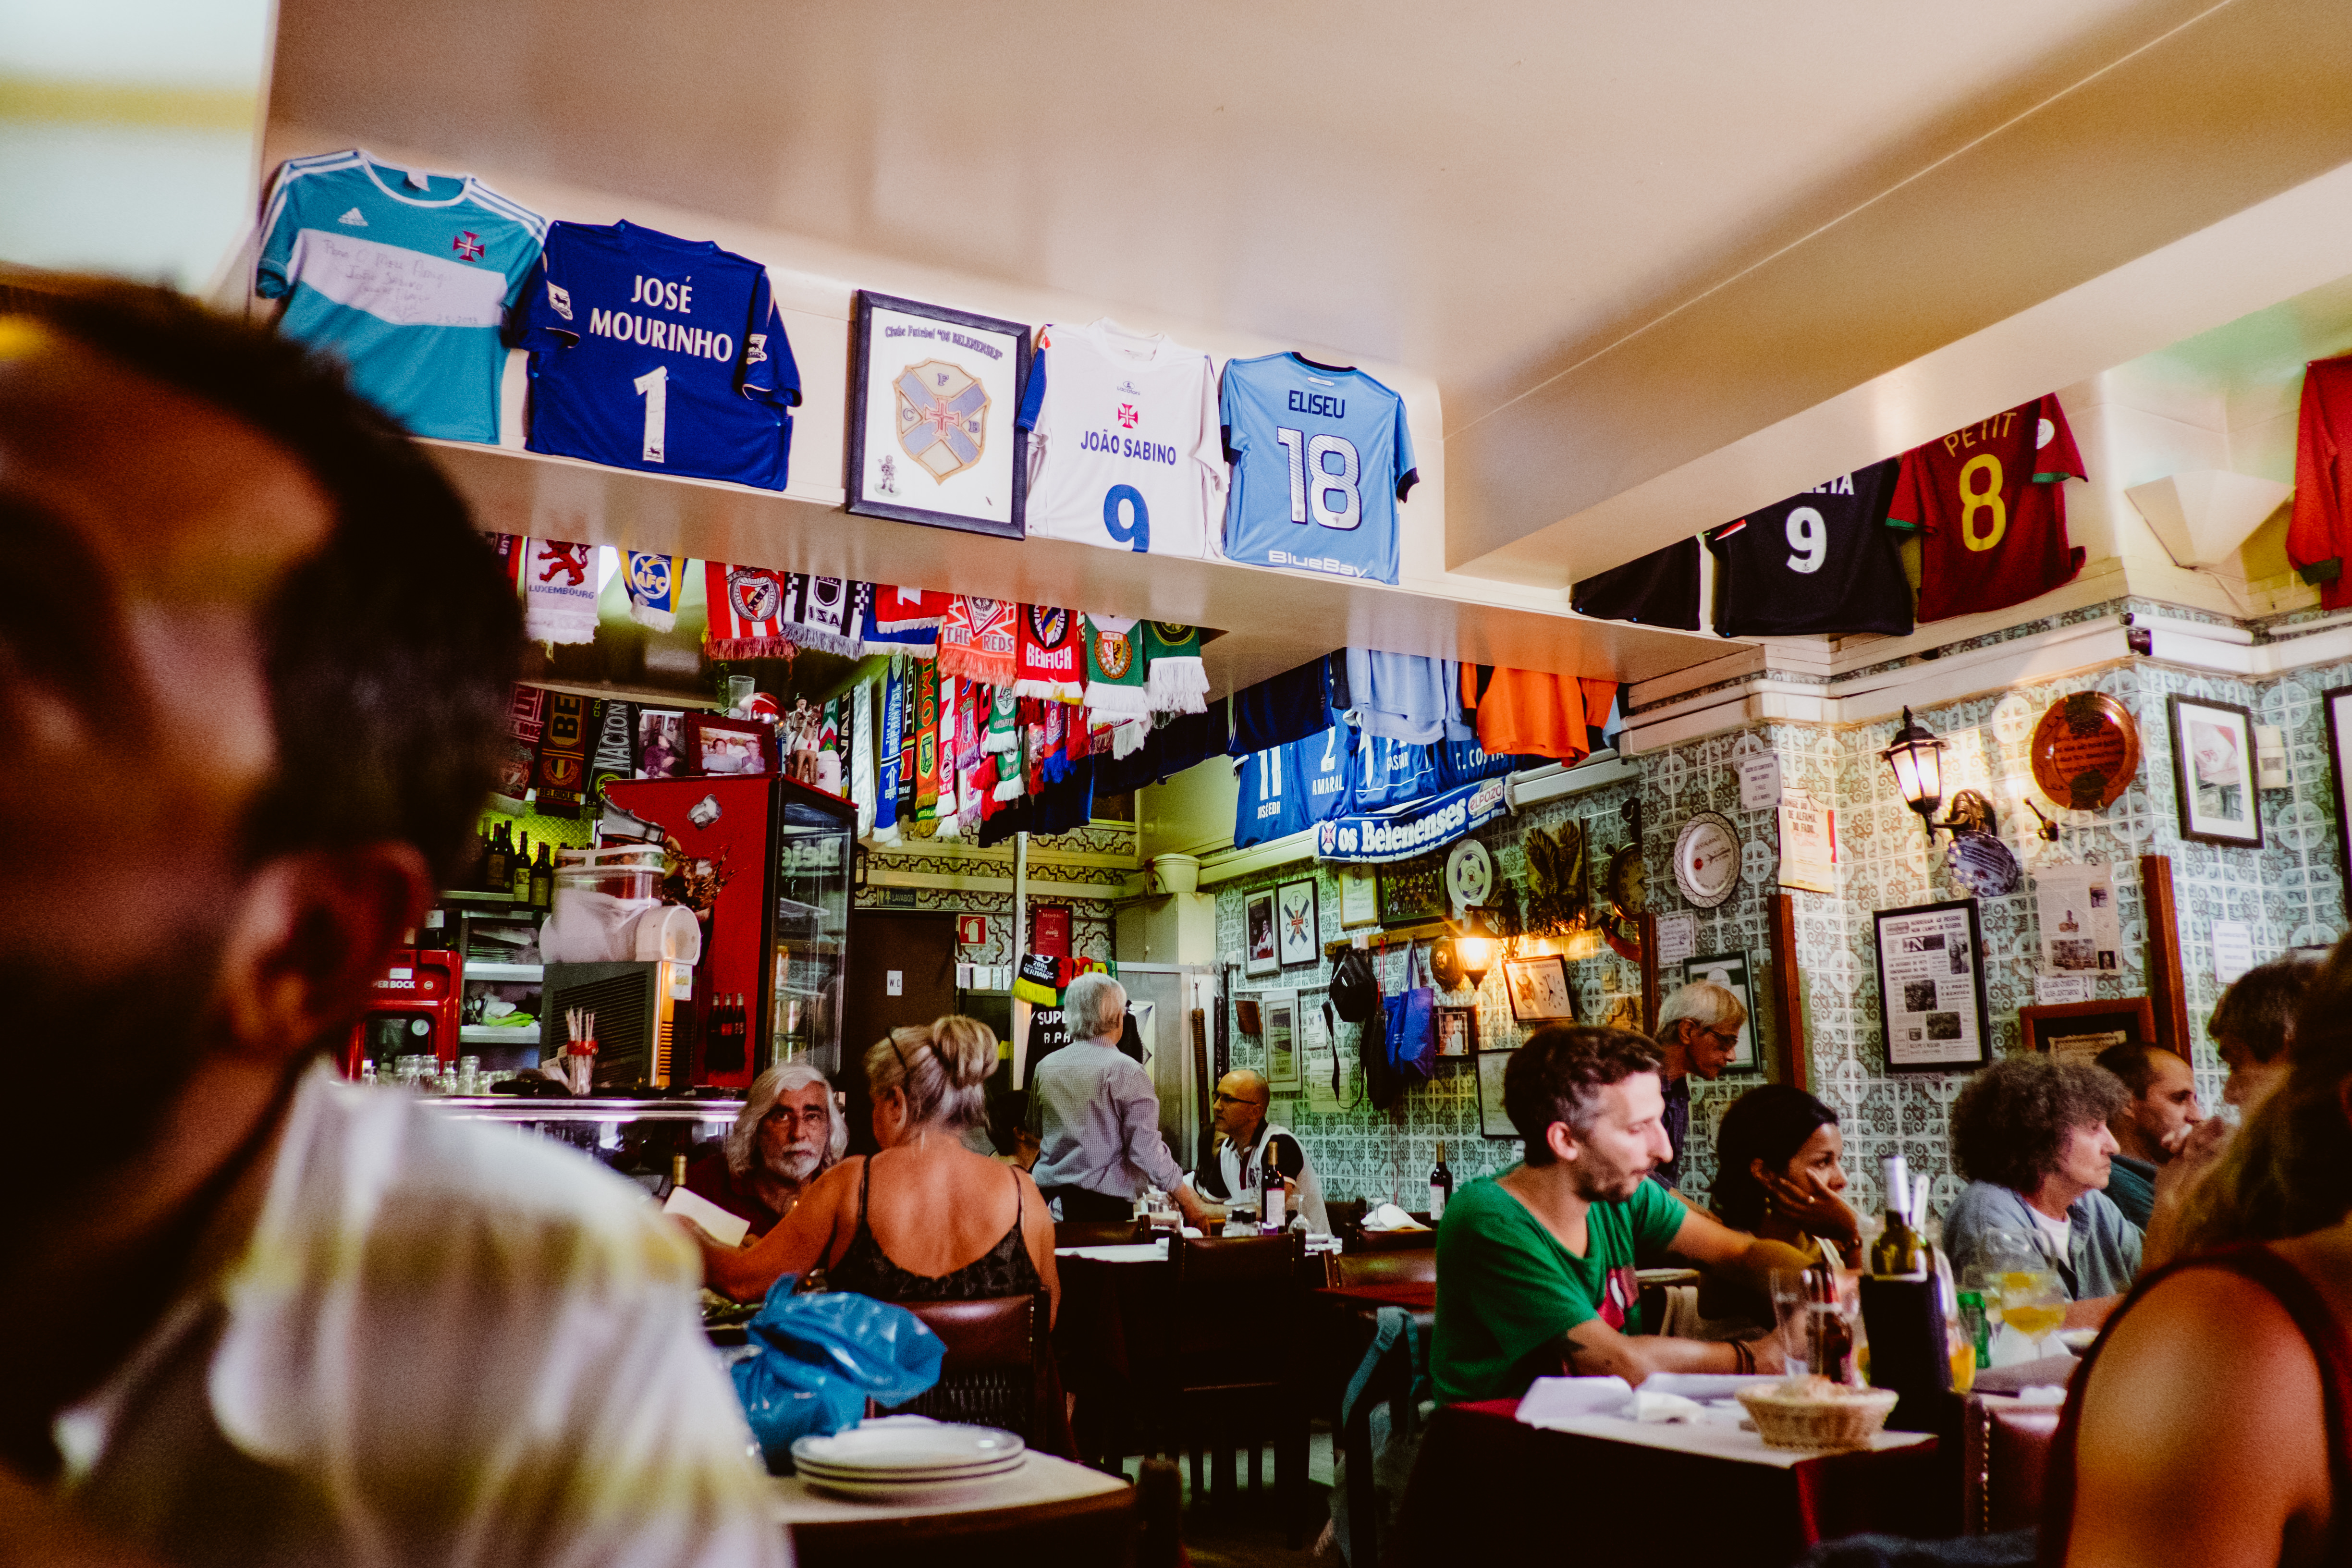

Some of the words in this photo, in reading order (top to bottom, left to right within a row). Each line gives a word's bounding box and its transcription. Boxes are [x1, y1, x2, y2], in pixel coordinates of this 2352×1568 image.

[631, 275, 693, 314] JOSÉ
[589, 307, 733, 362] MOURINHO
[938, 373, 949, 386] F
[634, 366, 668, 463] 1
[902, 407, 915, 421] C
[1289, 390, 1346, 419] ELISEU
[968, 420, 980, 433] B
[1943, 412, 2017, 457] PETIT
[1080, 429, 1120, 454] JOÃO
[1124, 438, 1176, 466] SABINO
[1277, 426, 1362, 531] 18
[1959, 453, 2007, 551] 8
[1103, 484, 1150, 553] 9
[1786, 506, 1826, 573] 9
[1269, 550, 1368, 578] BlueBay
[529, 584, 594, 600] LUXEMBOURG
[635, 571, 667, 593] AFC
[945, 626, 969, 645] THE
[984, 635, 1014, 652] REDS
[1026, 642, 1072, 669] BENFICA
[592, 698, 632, 771] NACION
[1257, 746, 1282, 801] 11
[1311, 774, 1345, 796] AMARAL
[1338, 827, 1358, 852] os
[1361, 797, 1467, 853] Belenenses
[892, 894, 914, 902] LAVABOS
[1294, 896, 1298, 906] F
[1286, 922, 1290, 931] C
[1305, 919, 1309, 928] B
[390, 980, 416, 989] BOCK
